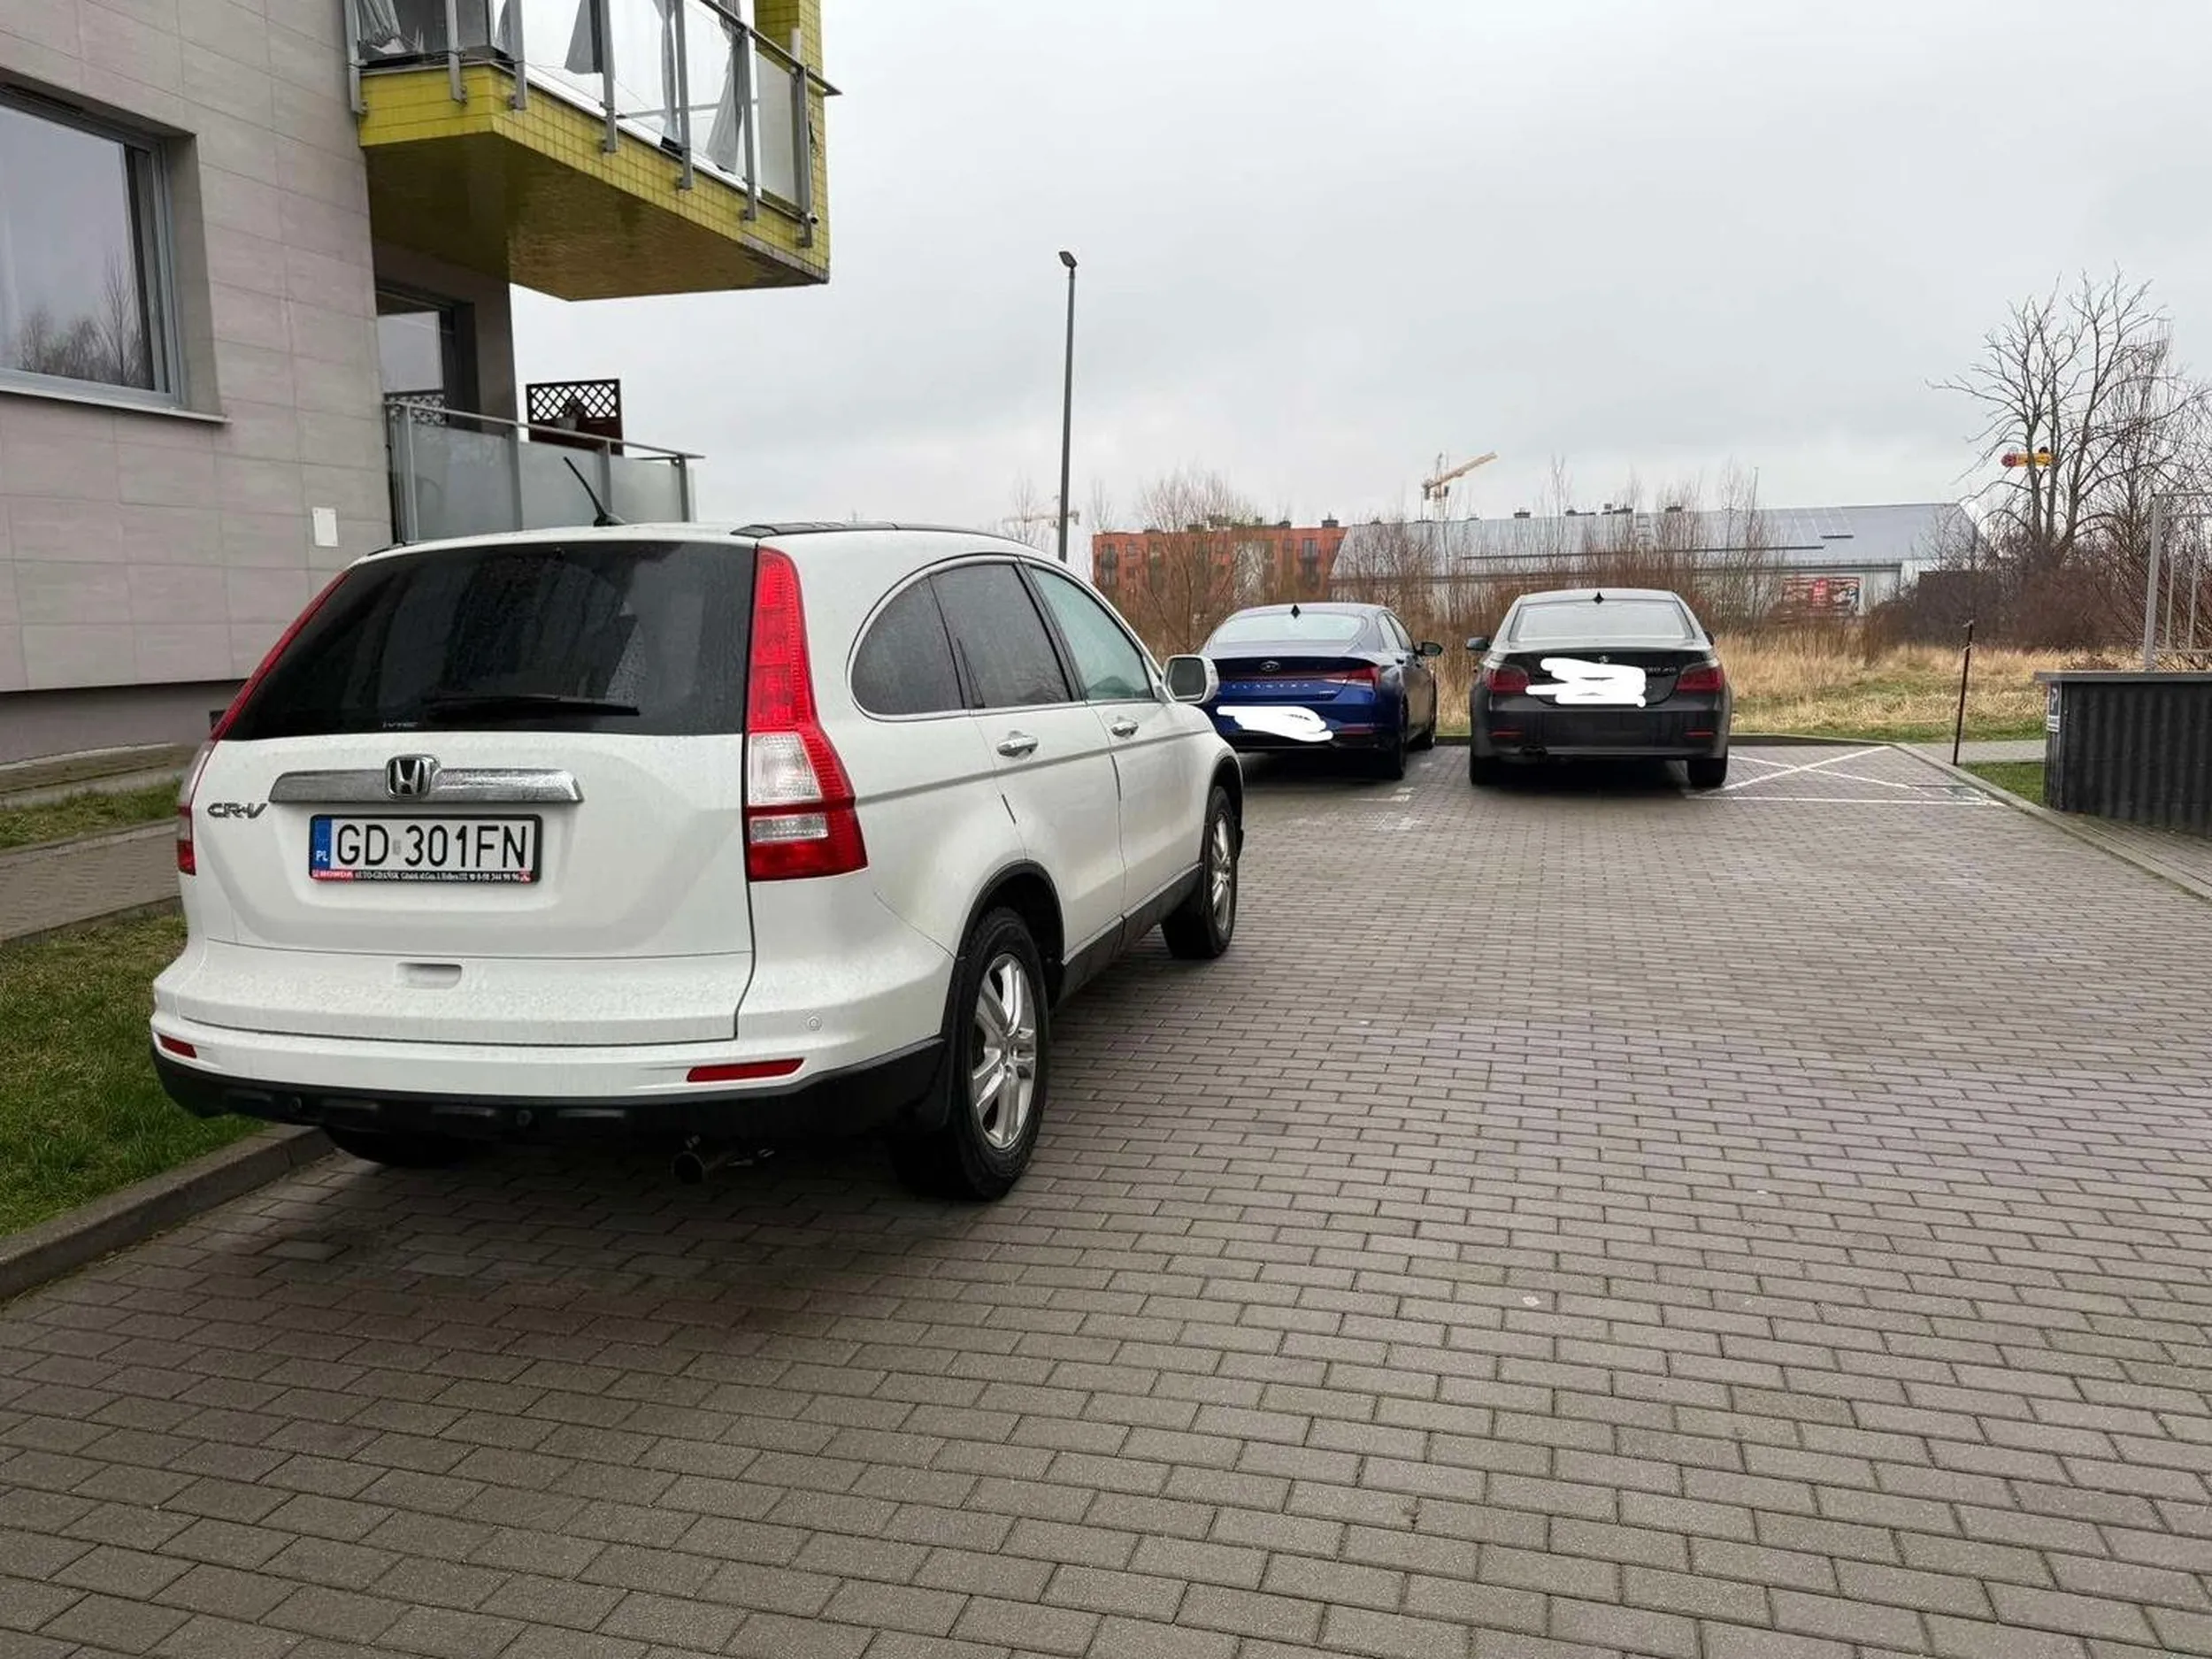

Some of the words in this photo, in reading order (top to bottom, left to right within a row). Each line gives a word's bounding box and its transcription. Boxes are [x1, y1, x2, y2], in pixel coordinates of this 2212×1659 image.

[207, 803, 268, 818] CR-V
[337, 824, 389, 866] GD
[404, 824, 526, 868] 301FN
[315, 849, 328, 862] PL
